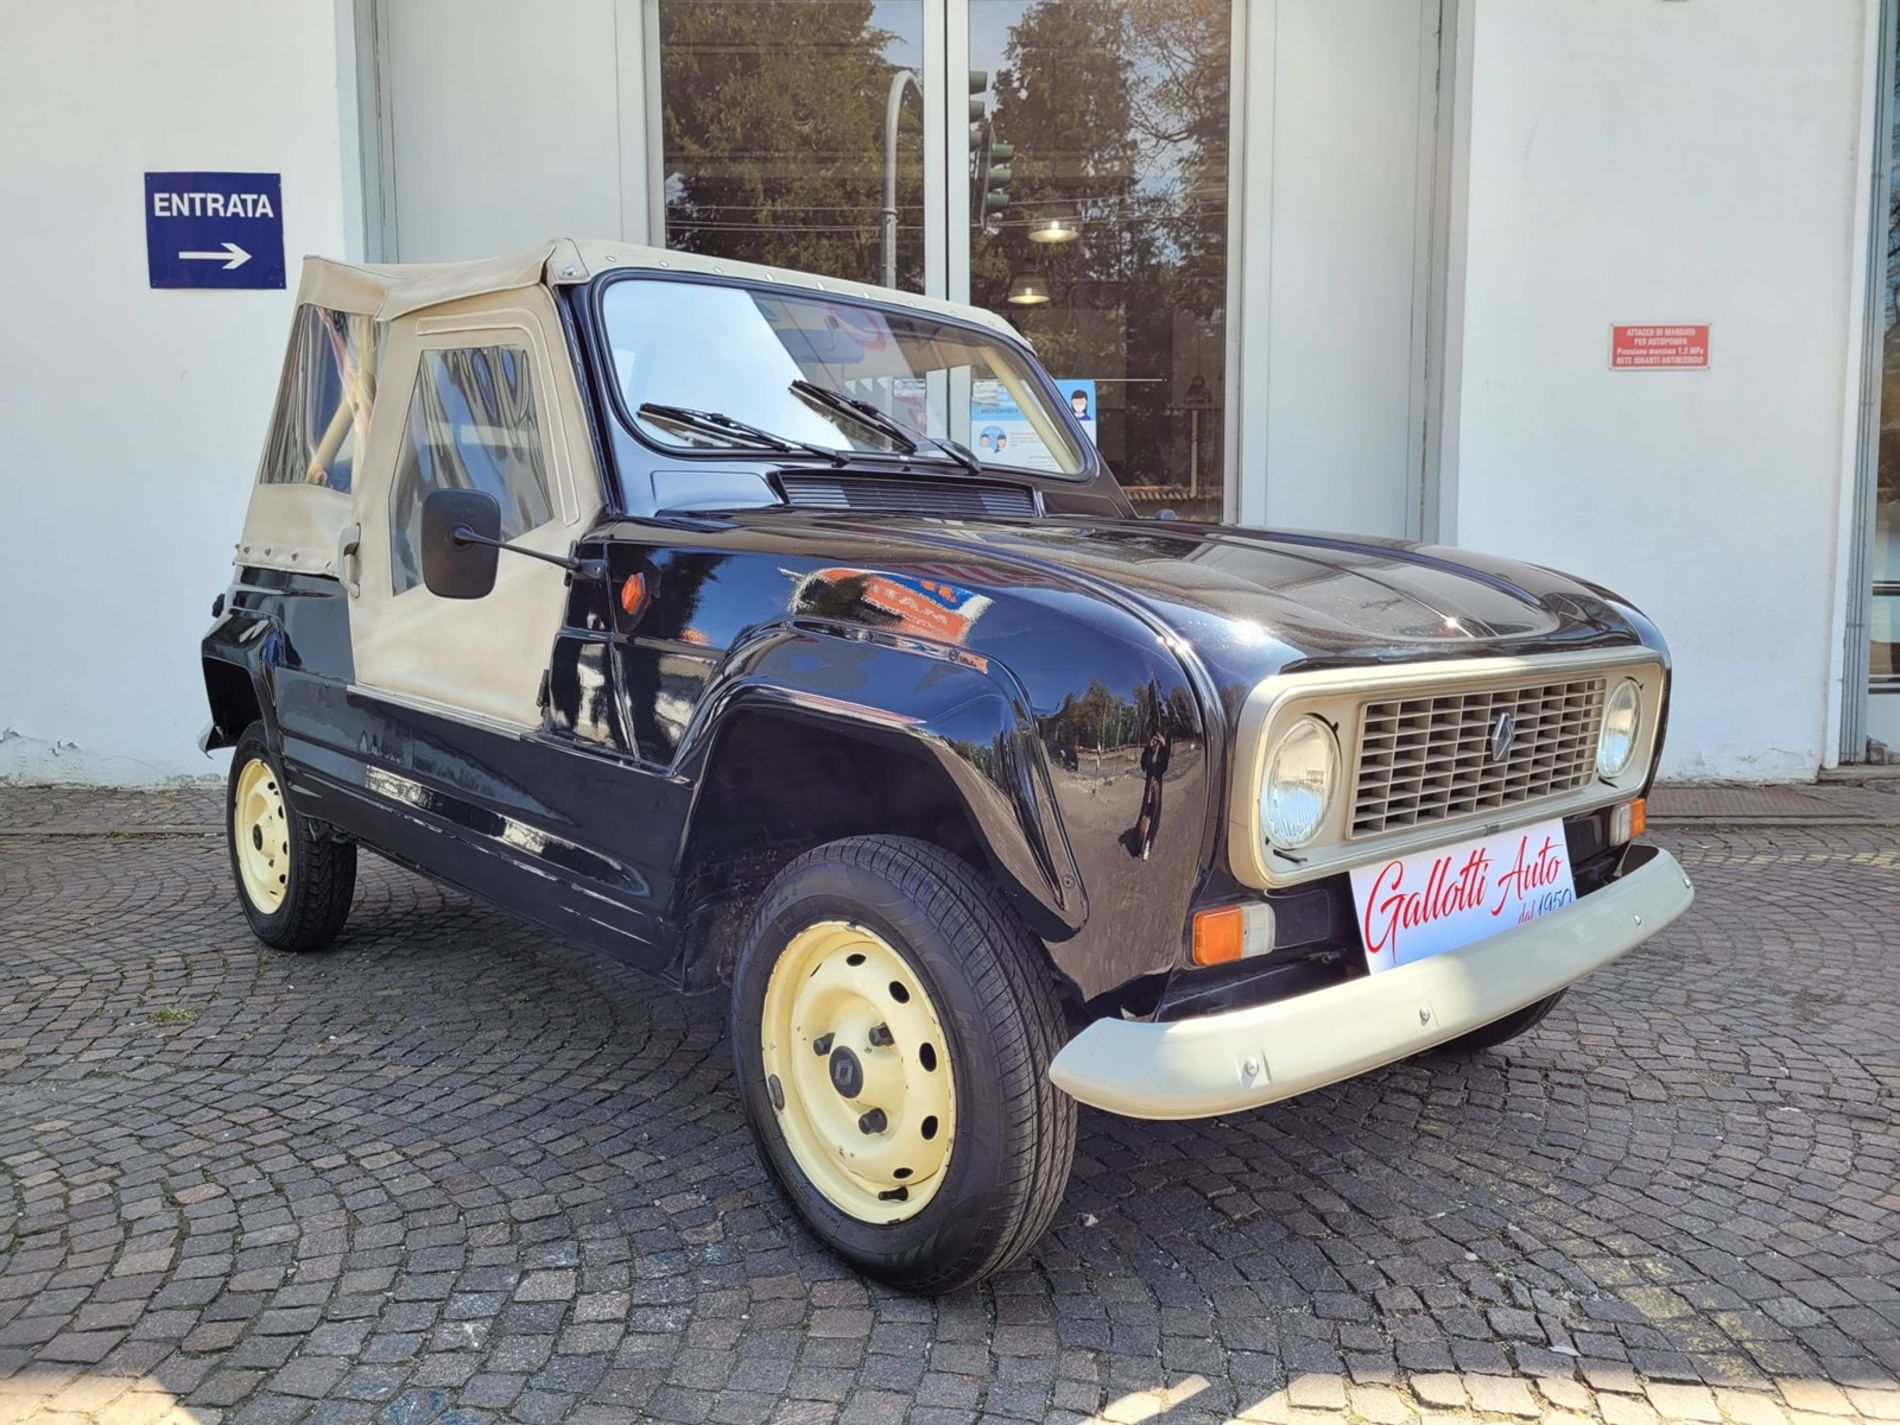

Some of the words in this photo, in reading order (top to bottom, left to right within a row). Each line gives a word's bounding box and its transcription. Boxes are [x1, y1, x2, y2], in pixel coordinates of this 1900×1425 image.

[153, 192, 275, 218] ENTRATA
[1626, 328, 1655, 336] ATTACCO
[1656, 328, 1663, 336] DI
[1664, 328, 1696, 336] MANDATA
[1633, 337, 1647, 346] PER
[1616, 347, 1647, 355] Pressione
[1616, 356, 1632, 364] RETE
[1633, 356, 1660, 364] IDRANTI
[1661, 356, 1704, 364] ANTINCENDIO
[1364, 847, 1495, 964] Gallotti
[1490, 835, 1564, 917] Auto
[1518, 899, 1536, 924] dal
[1538, 888, 1572, 916] 1950
